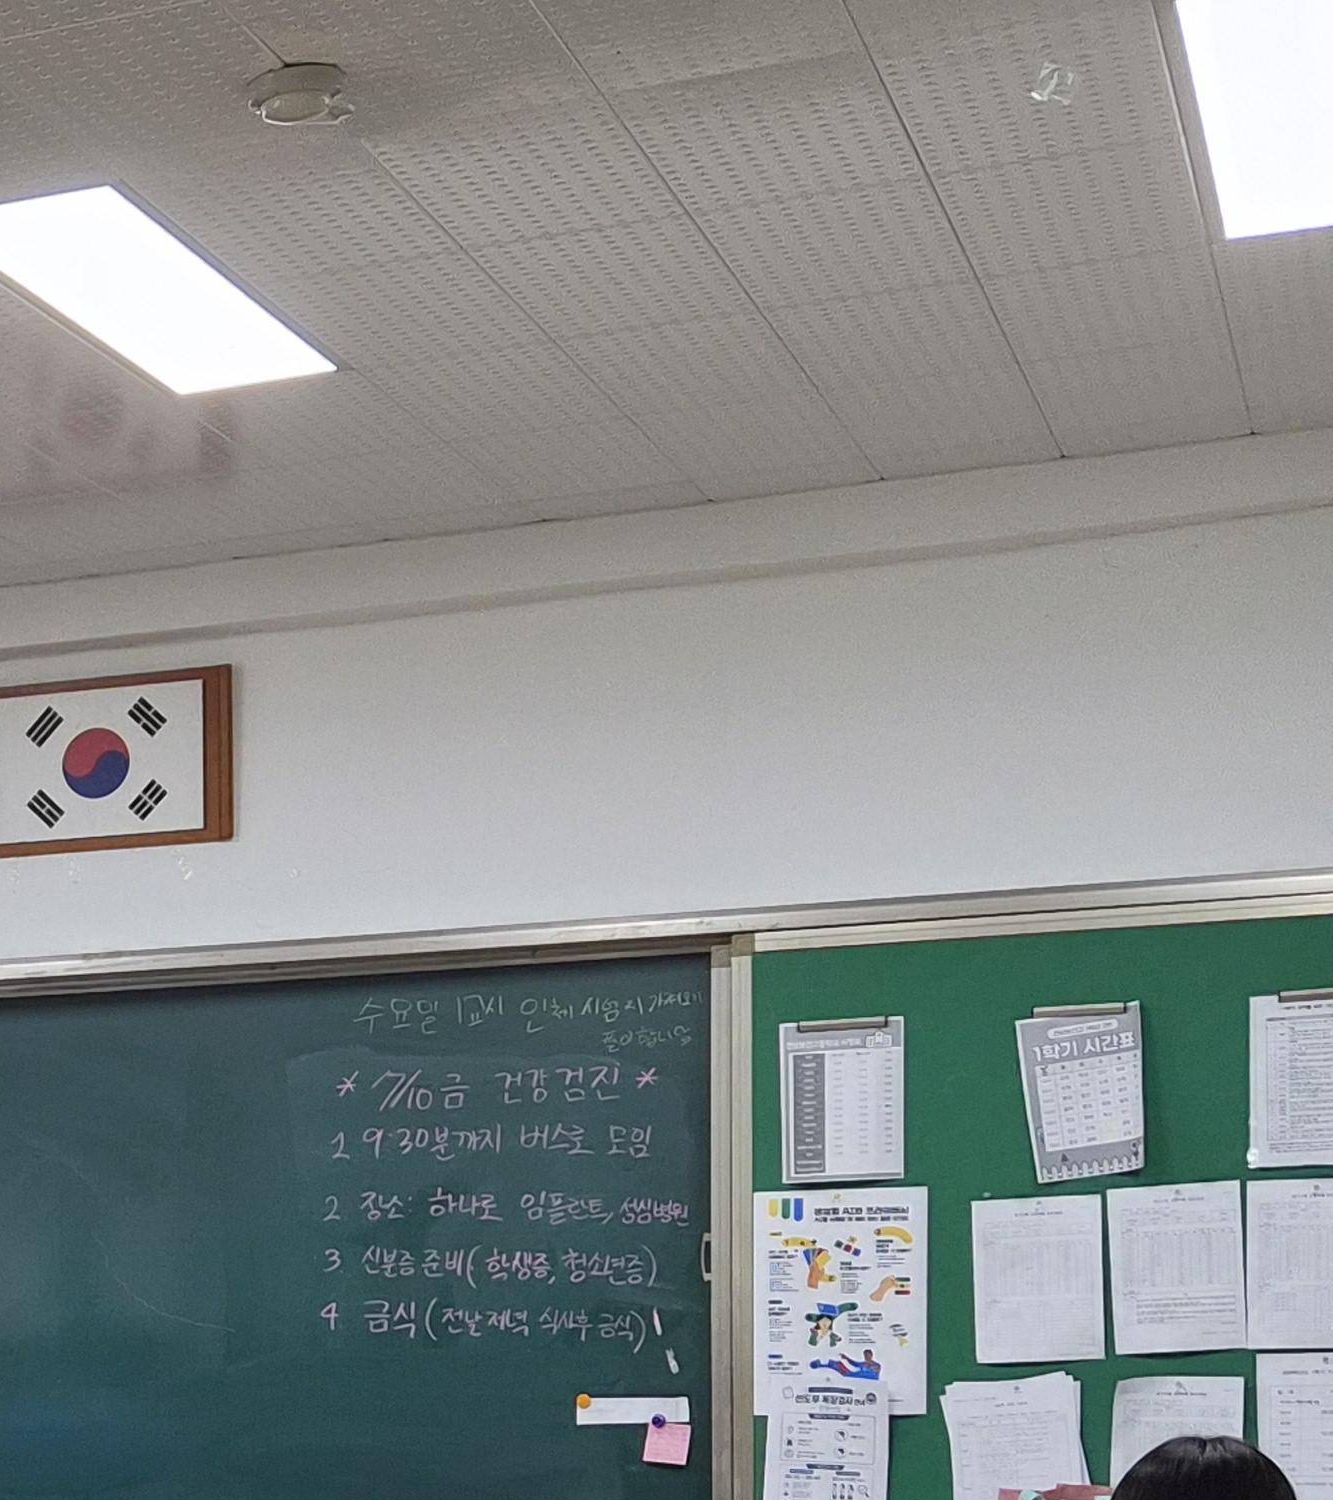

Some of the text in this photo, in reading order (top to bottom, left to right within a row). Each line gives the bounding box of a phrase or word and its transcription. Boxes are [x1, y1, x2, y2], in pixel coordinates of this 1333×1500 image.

[354, 998, 438, 1034] 수요일
[1031, 1031, 1136, 1062] 1학기 시간표
[495, 1064, 621, 1104] 건강검진
[520, 1123, 594, 1155] 버스로
[428, 1186, 504, 1222] 하나로
[361, 1245, 416, 1279] 신분증
